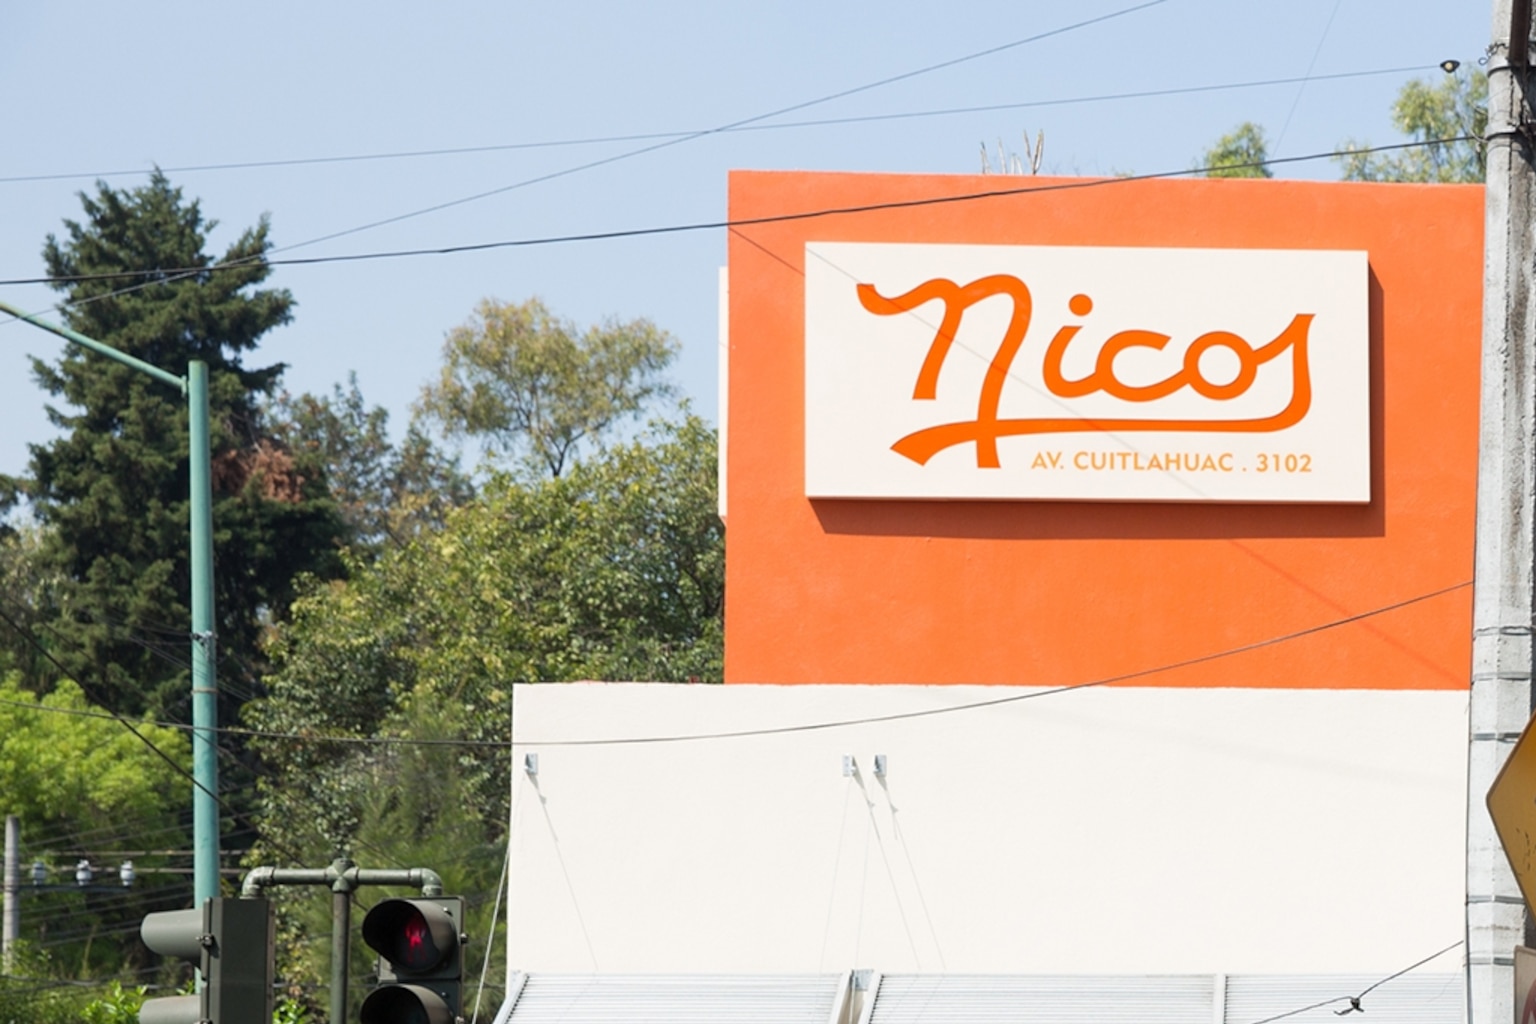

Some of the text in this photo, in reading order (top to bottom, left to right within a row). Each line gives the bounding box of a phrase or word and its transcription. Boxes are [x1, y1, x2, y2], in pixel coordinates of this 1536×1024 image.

[1031, 451, 1064, 470] AV.
[1074, 452, 1234, 473] CUITLAHUAC
[1256, 453, 1313, 474] 3102
